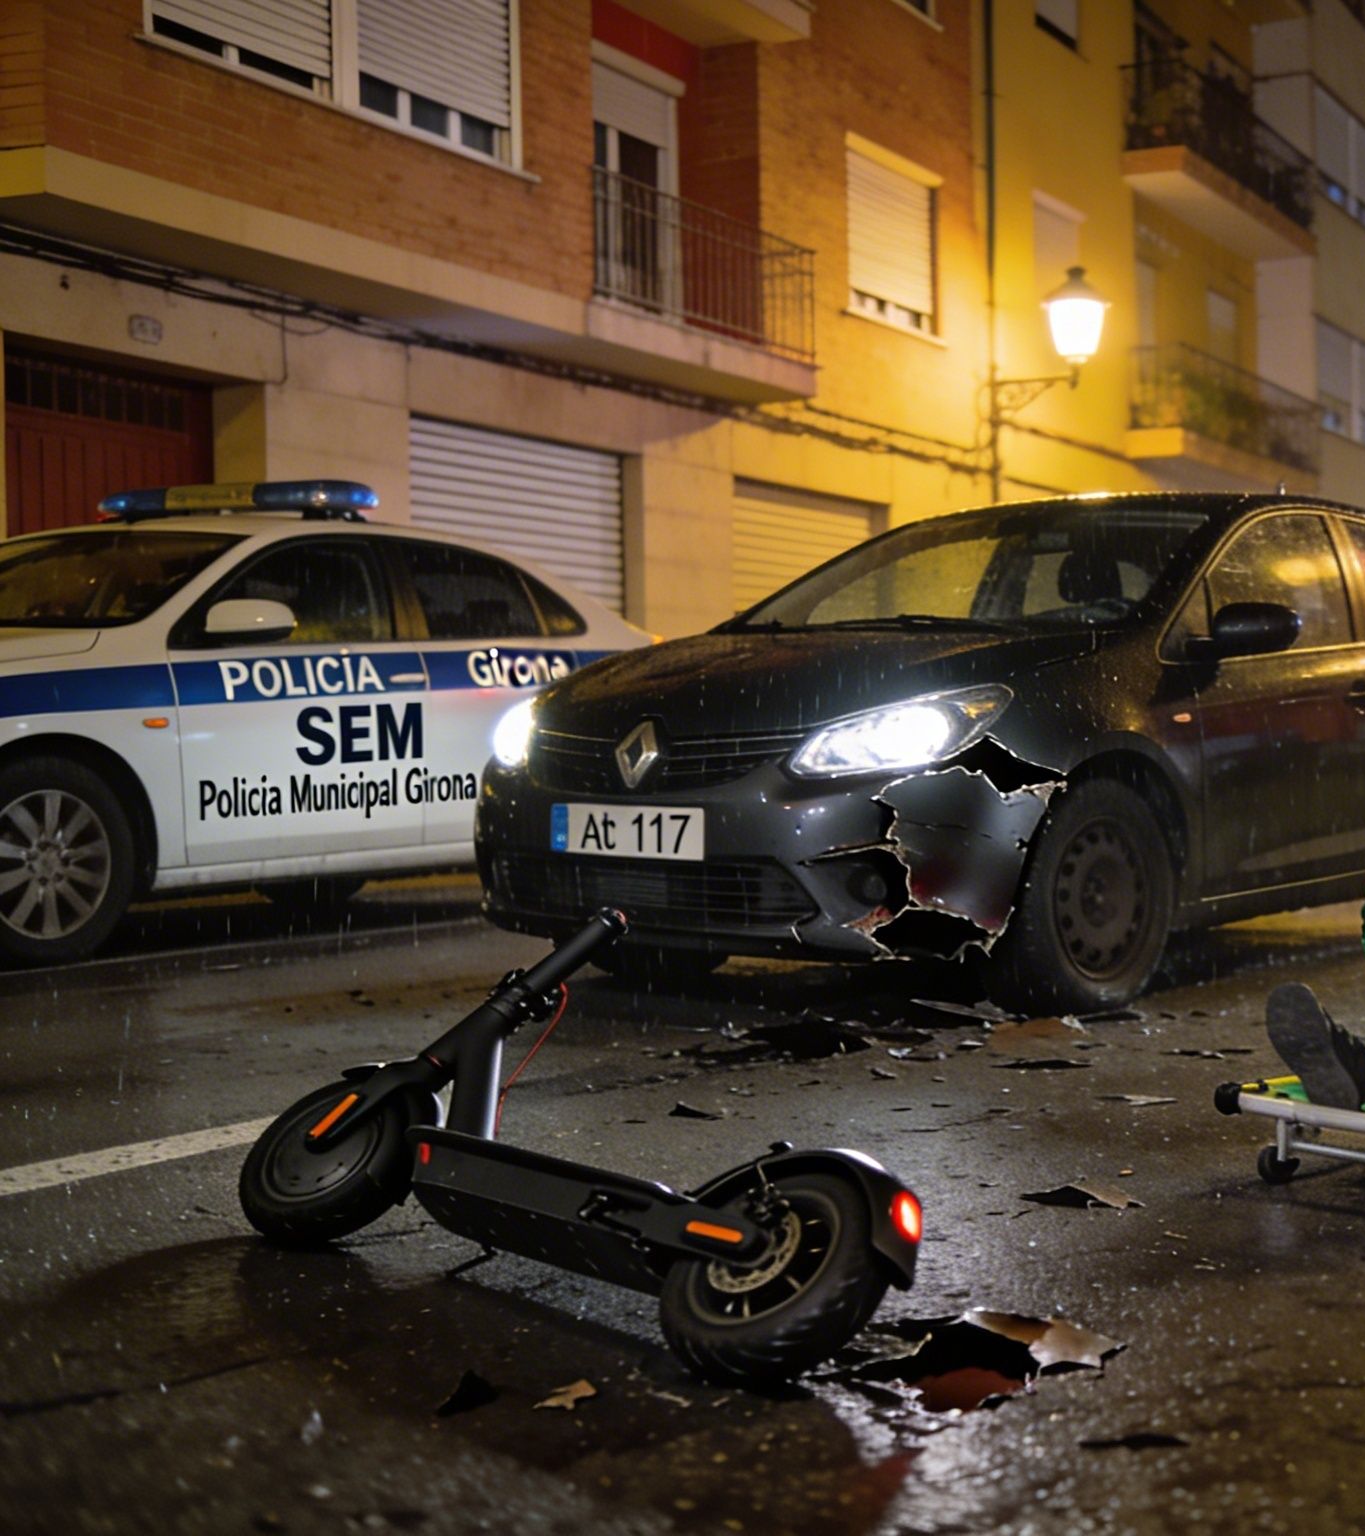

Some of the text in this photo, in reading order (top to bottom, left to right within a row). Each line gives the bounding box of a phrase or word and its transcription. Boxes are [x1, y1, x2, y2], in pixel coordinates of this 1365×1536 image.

[467, 648, 570, 688] Girona
[296, 702, 424, 766] SEM
[290, 768, 398, 819] Municipal
[405, 767, 477, 804] Girona
[632, 812, 691, 854] 117
